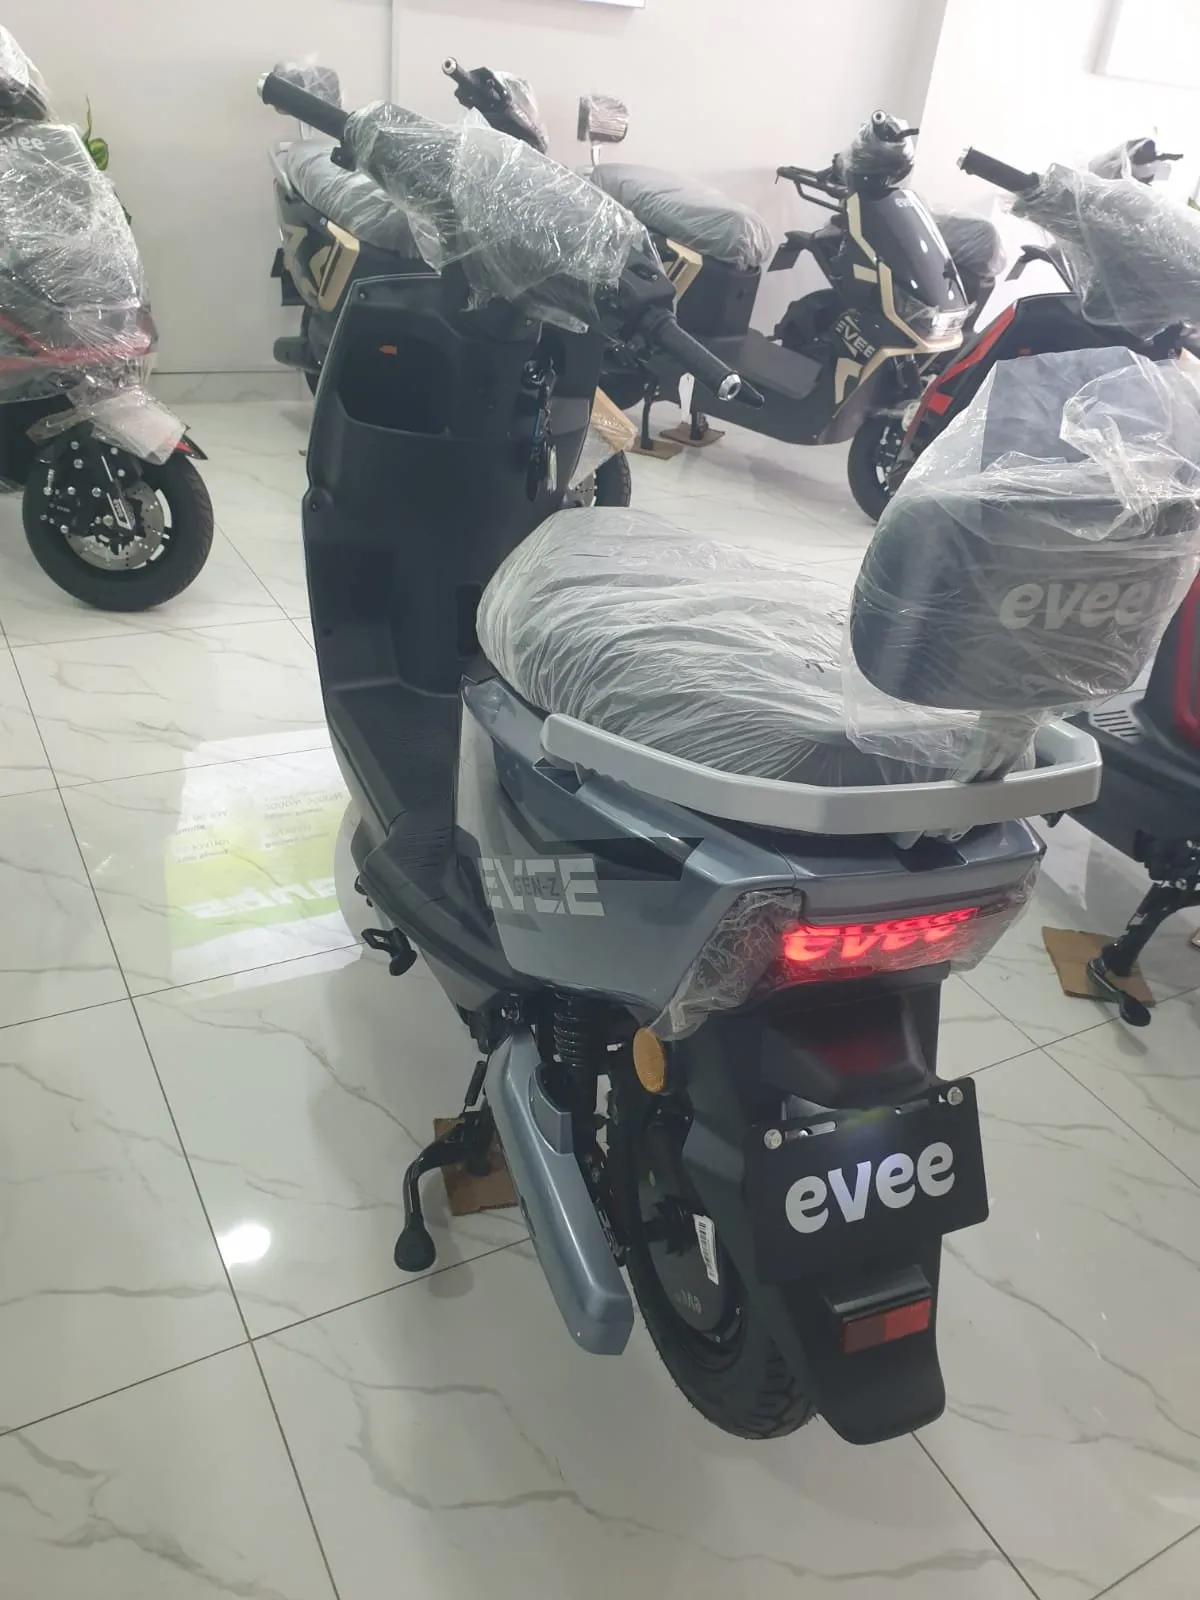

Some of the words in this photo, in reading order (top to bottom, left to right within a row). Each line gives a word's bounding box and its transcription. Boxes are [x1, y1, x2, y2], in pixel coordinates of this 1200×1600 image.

[0, 136, 46, 151] vee
[999, 582, 1153, 630] evee
[785, 1142, 955, 1234] evee
